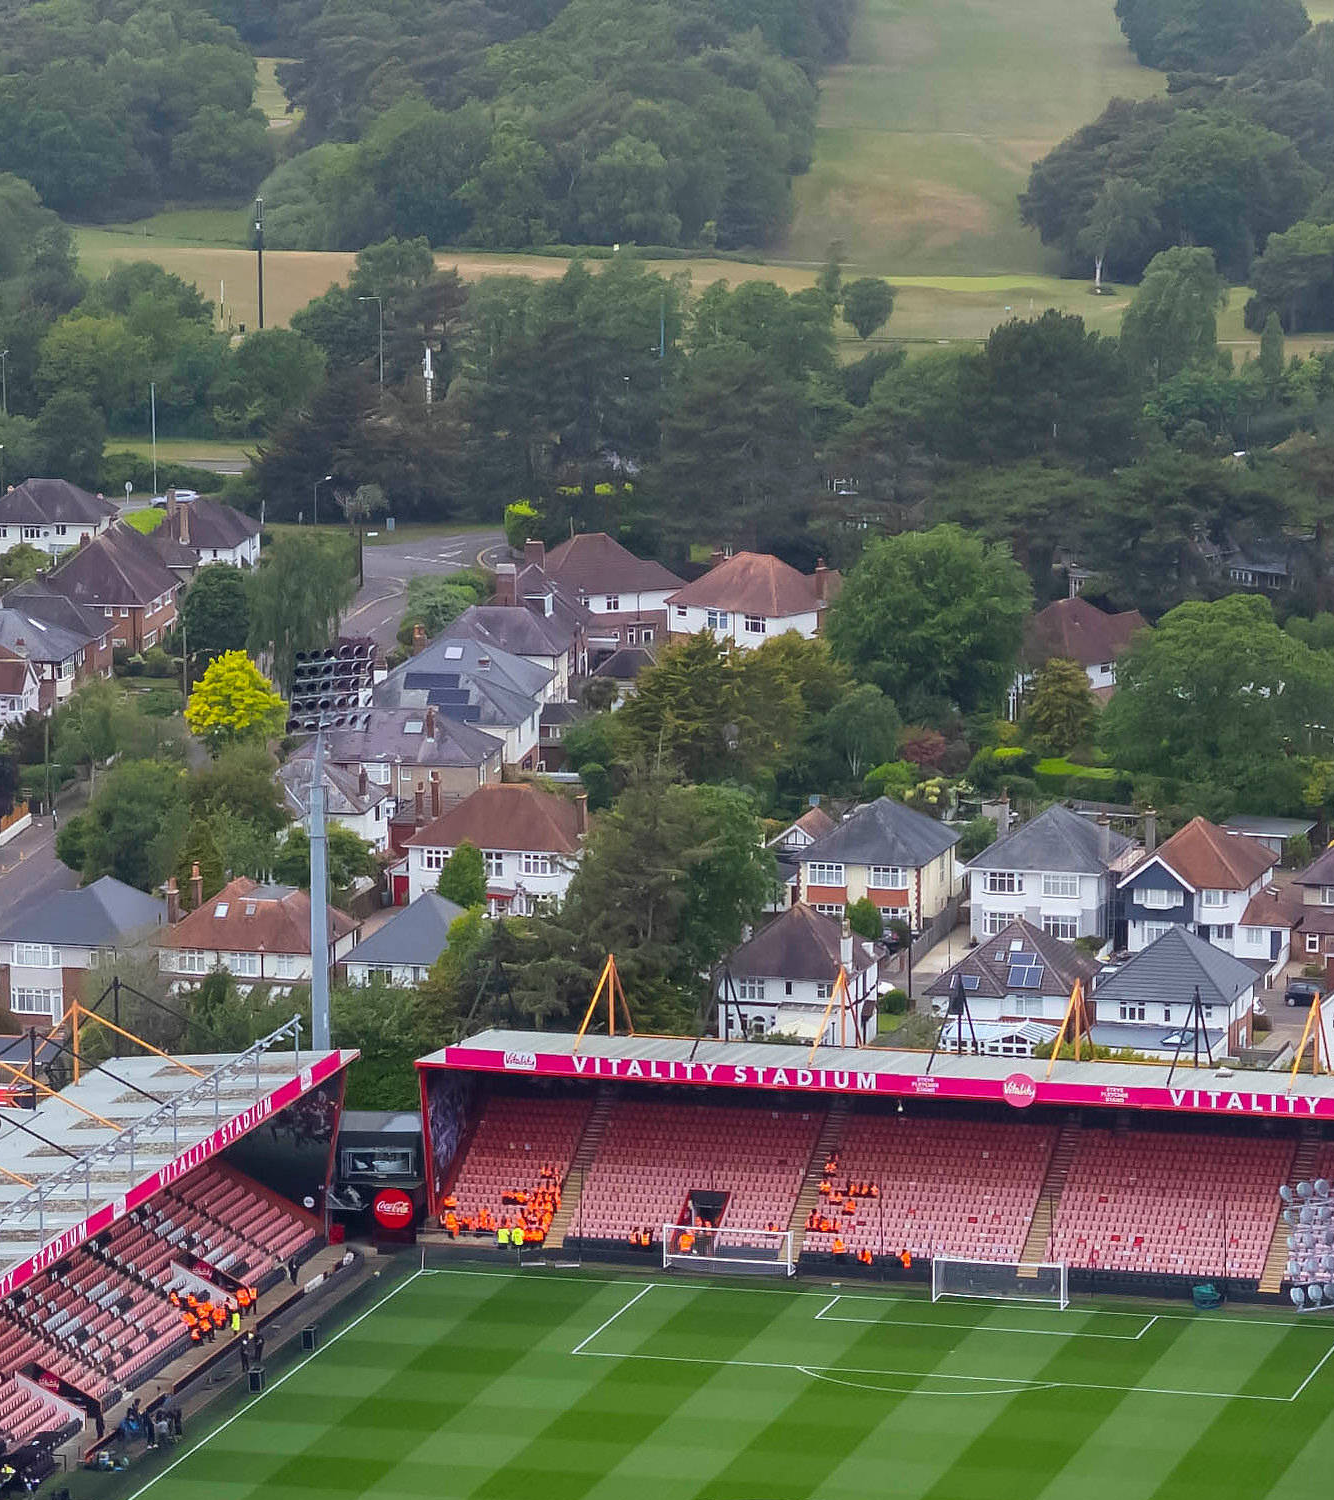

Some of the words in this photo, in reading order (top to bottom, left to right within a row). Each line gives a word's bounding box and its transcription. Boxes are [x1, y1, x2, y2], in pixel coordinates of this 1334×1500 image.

[571, 1055, 717, 1081] VITALITY
[733, 1066, 877, 1090] STADIUM
[1169, 1089, 1321, 1114] VITALITY
[158, 1134, 217, 1186] VITALITY
[221, 1096, 272, 1144] STADIUM
[32, 1223, 88, 1274] STADIUM
